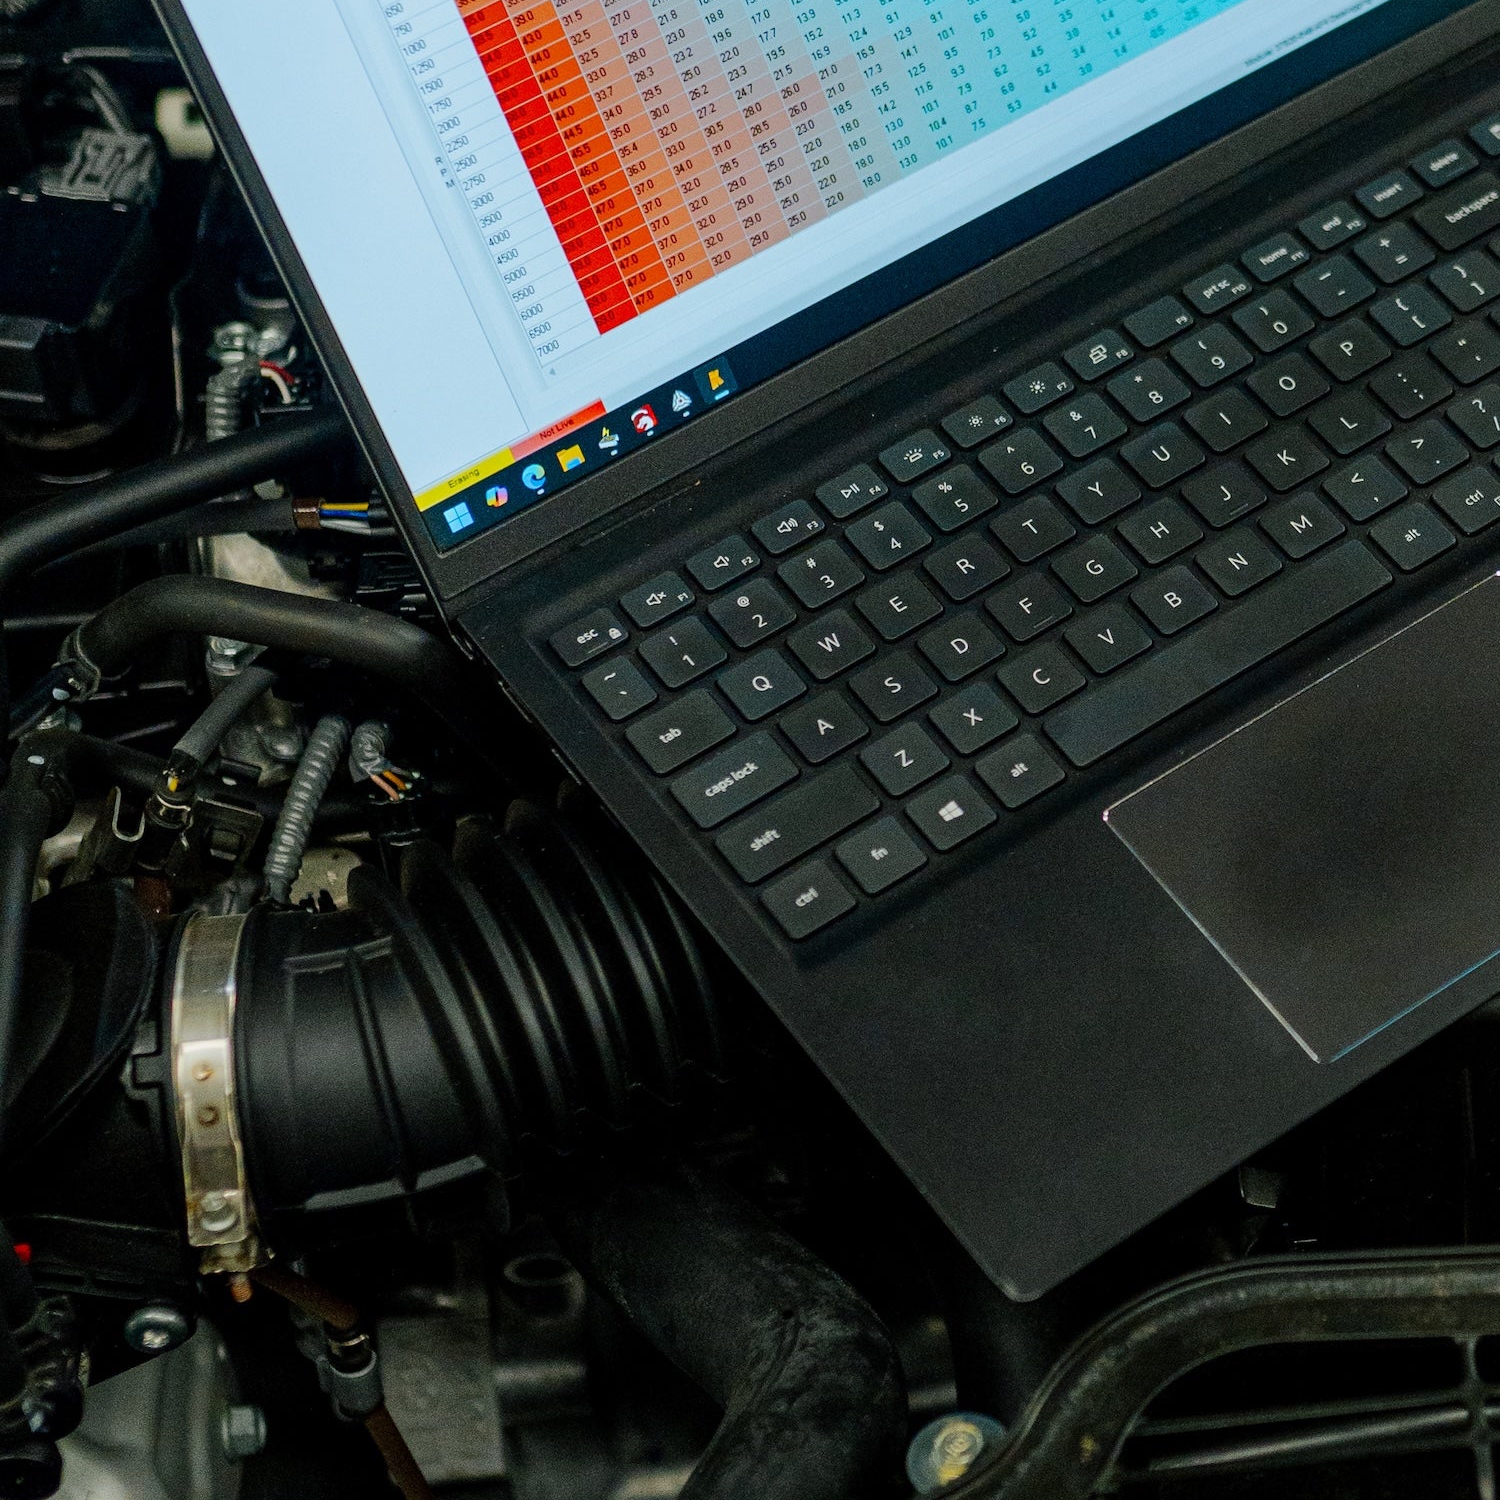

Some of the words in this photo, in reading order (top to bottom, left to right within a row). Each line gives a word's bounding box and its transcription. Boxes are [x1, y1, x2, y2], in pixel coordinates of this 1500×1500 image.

[394, 22, 412, 38] 750
[618, 29, 639, 46] 27.8
[570, 30, 591, 47] 32.5
[402, 39, 426, 57] 1000
[420, 78, 444, 96] 1500
[735, 83, 754, 100] 24.7
[437, 116, 461, 135] 2000
[704, 120, 724, 137] 30.5
[454, 154, 477, 173] 2500
[471, 192, 494, 210] 3000
[1446, 192, 1498, 223] backspace
[488, 229, 511, 247] 4000
[750, 230, 769, 247] 29.0
[712, 250, 731, 267] 32.0
[1260, 248, 1287, 265] home
[504, 266, 527, 285] 5000
[520, 303, 544, 322] 6000
[536, 340, 560, 358] 7000
[1340, 342, 1353, 356] P
[1211, 356, 1225, 369] 9
[1149, 391, 1163, 403] 8
[539, 428, 556, 442] Not
[556, 416, 575, 433] Live
[1340, 418, 1357, 429] L
[1085, 426, 1096, 438] 7
[1152, 446, 1170, 461] U
[1277, 450, 1295, 465] K
[1021, 462, 1034, 474] 6
[448, 466, 481, 490] Erasing
[1088, 482, 1103, 496] Y
[1221, 486, 1231, 501] J
[955, 499, 968, 512] 5
[1466, 490, 1484, 505] ctrl
[1022, 519, 1037, 533] T
[1150, 522, 1169, 538] H
[1290, 515, 1312, 533] M
[891, 538, 901, 549] 4
[1405, 529, 1420, 542] alt
[956, 559, 975, 574] R
[1086, 560, 1104, 574] G
[1228, 553, 1248, 570] N
[820, 575, 834, 588] 3
[889, 596, 907, 612] E
[1019, 598, 1032, 613] F
[1164, 592, 1181, 607] B
[752, 614, 767, 627] 2
[577, 629, 598, 643] esc
[818, 633, 840, 652] W
[1098, 629, 1114, 644] V
[951, 638, 968, 654] D
[683, 655, 694, 665] 1
[752, 676, 772, 691] Q
[1033, 669, 1050, 684] C
[885, 677, 901, 693] S
[963, 708, 983, 726] X
[817, 719, 834, 735] A
[659, 728, 681, 743] tab
[894, 750, 913, 767] Z
[704, 775, 733, 799] caps
[731, 760, 759, 783] lock
[751, 830, 780, 851] shift
[871, 848, 888, 860] fn
[796, 888, 818, 906] ctrl
